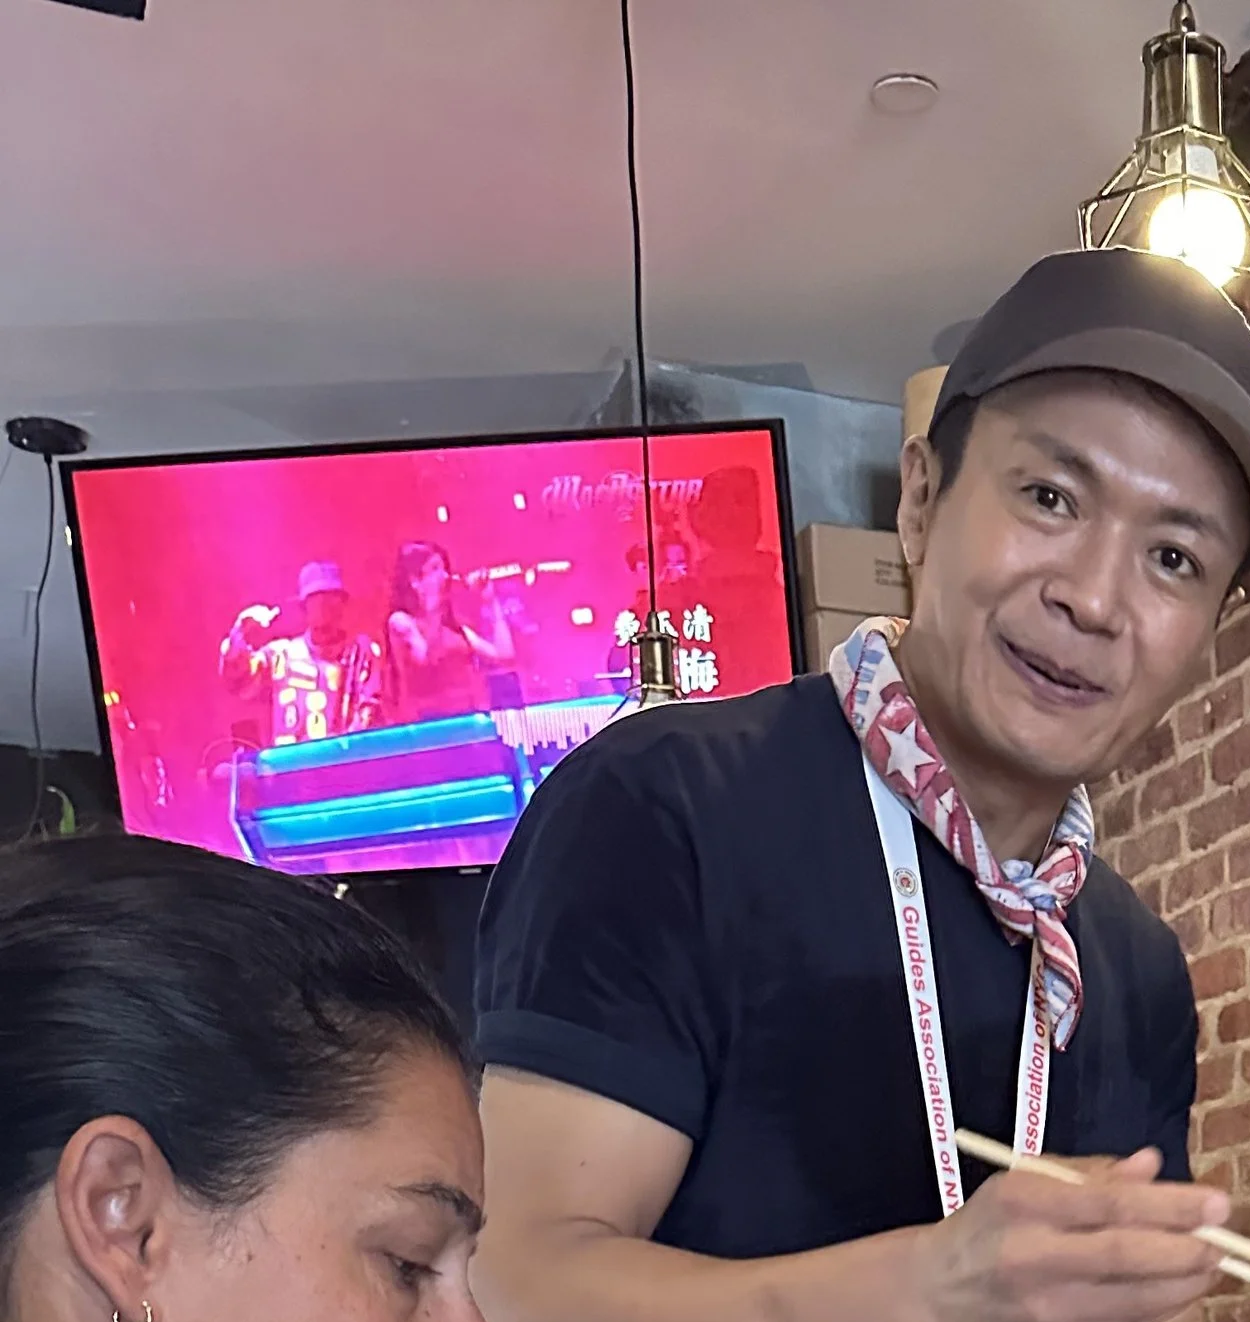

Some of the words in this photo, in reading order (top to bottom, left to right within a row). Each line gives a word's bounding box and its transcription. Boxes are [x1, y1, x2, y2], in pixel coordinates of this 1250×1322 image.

[903, 906, 926, 992] Guides
[916, 999, 947, 1143] Association
[1021, 1043, 1045, 1156] ssociation
[1033, 1011, 1047, 1038] of
[940, 1150, 956, 1176] of
[944, 1181, 960, 1211] NY
